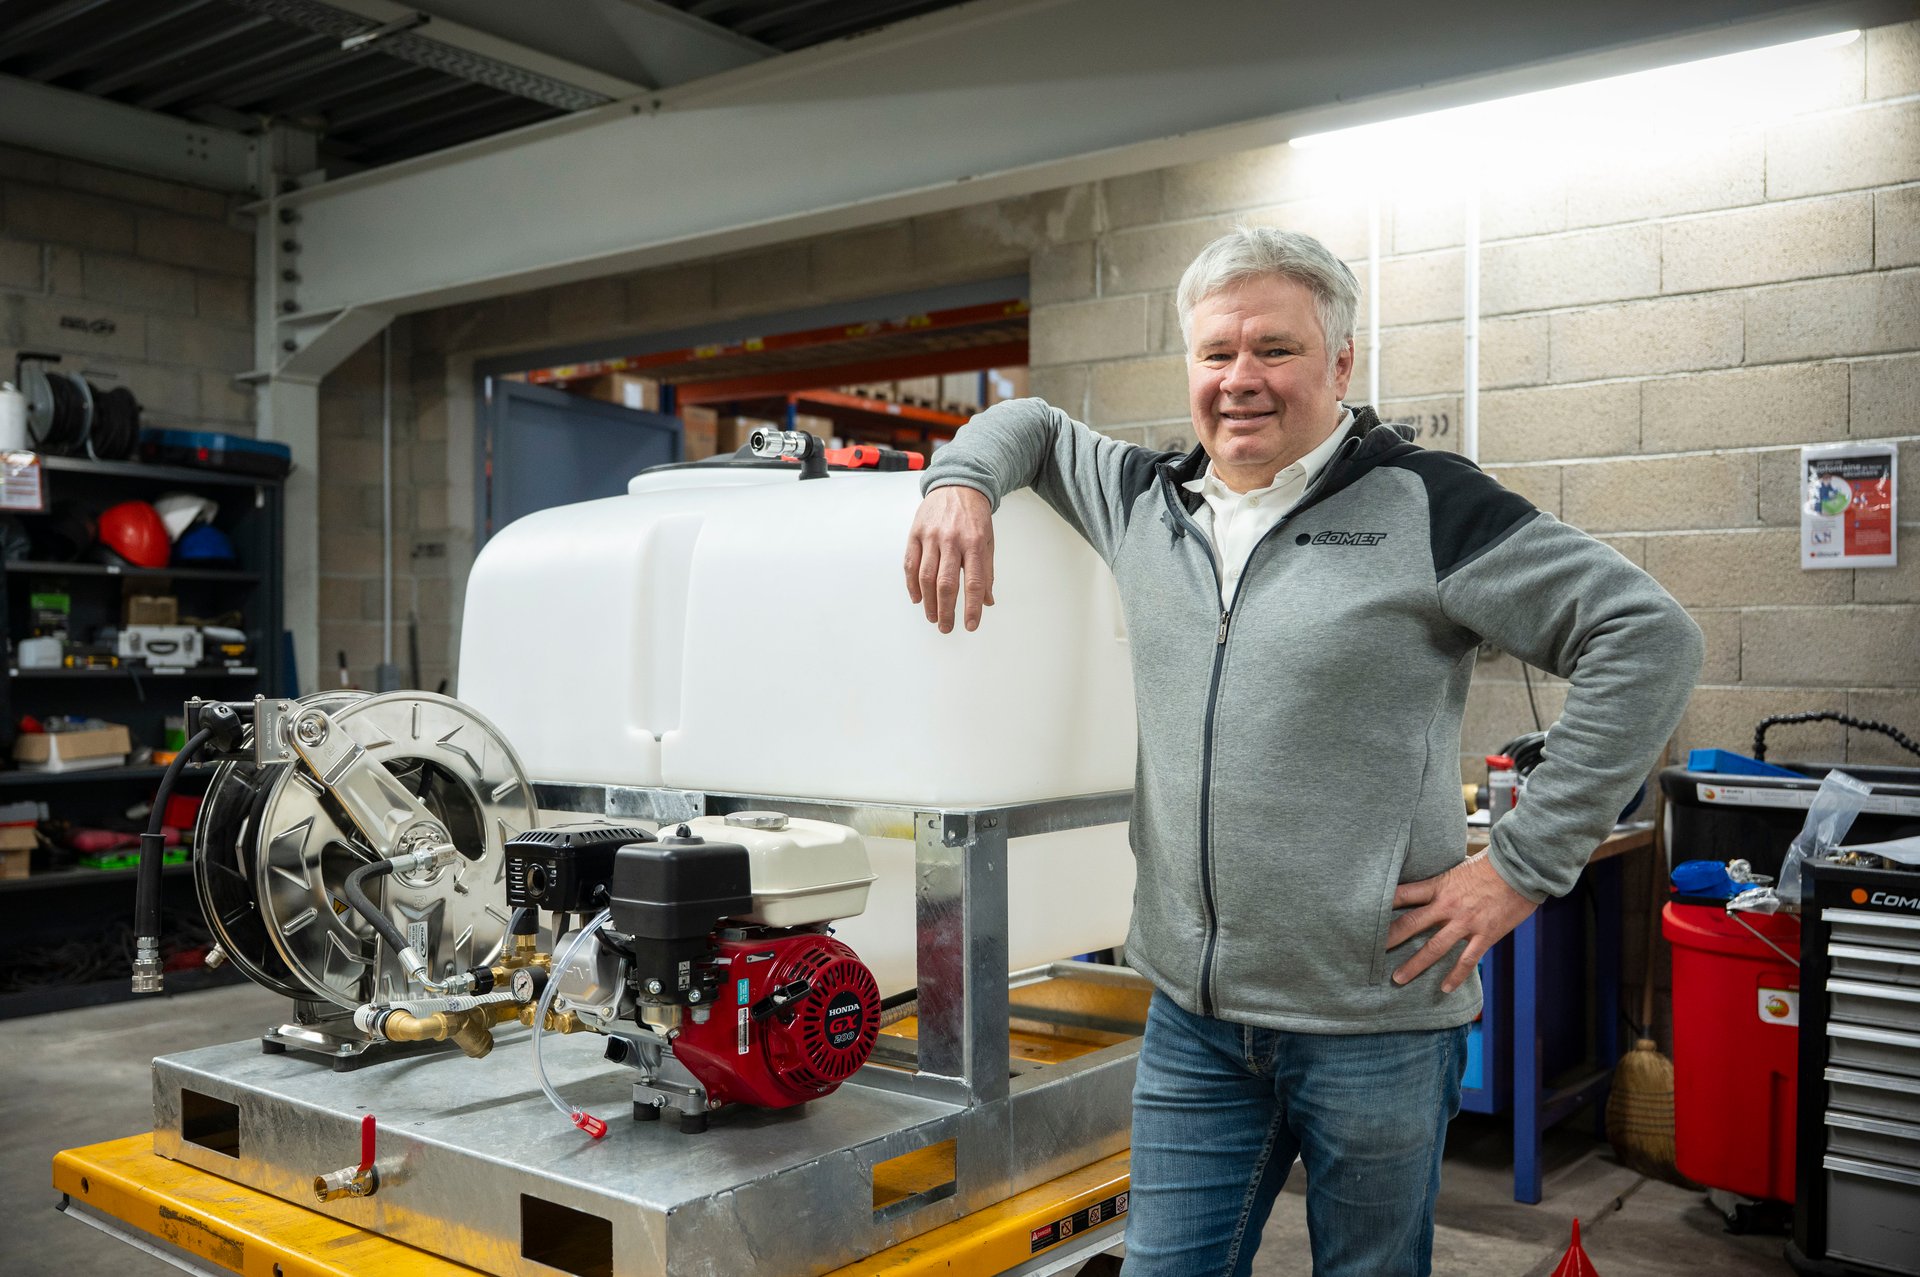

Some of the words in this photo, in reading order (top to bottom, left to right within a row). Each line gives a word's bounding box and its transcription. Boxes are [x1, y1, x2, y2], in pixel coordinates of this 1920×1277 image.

[1311, 531, 1387, 546] COMET
[829, 1003, 860, 1017] HONDA
[829, 1014, 859, 1034] GX
[834, 1031, 855, 1044] 200
